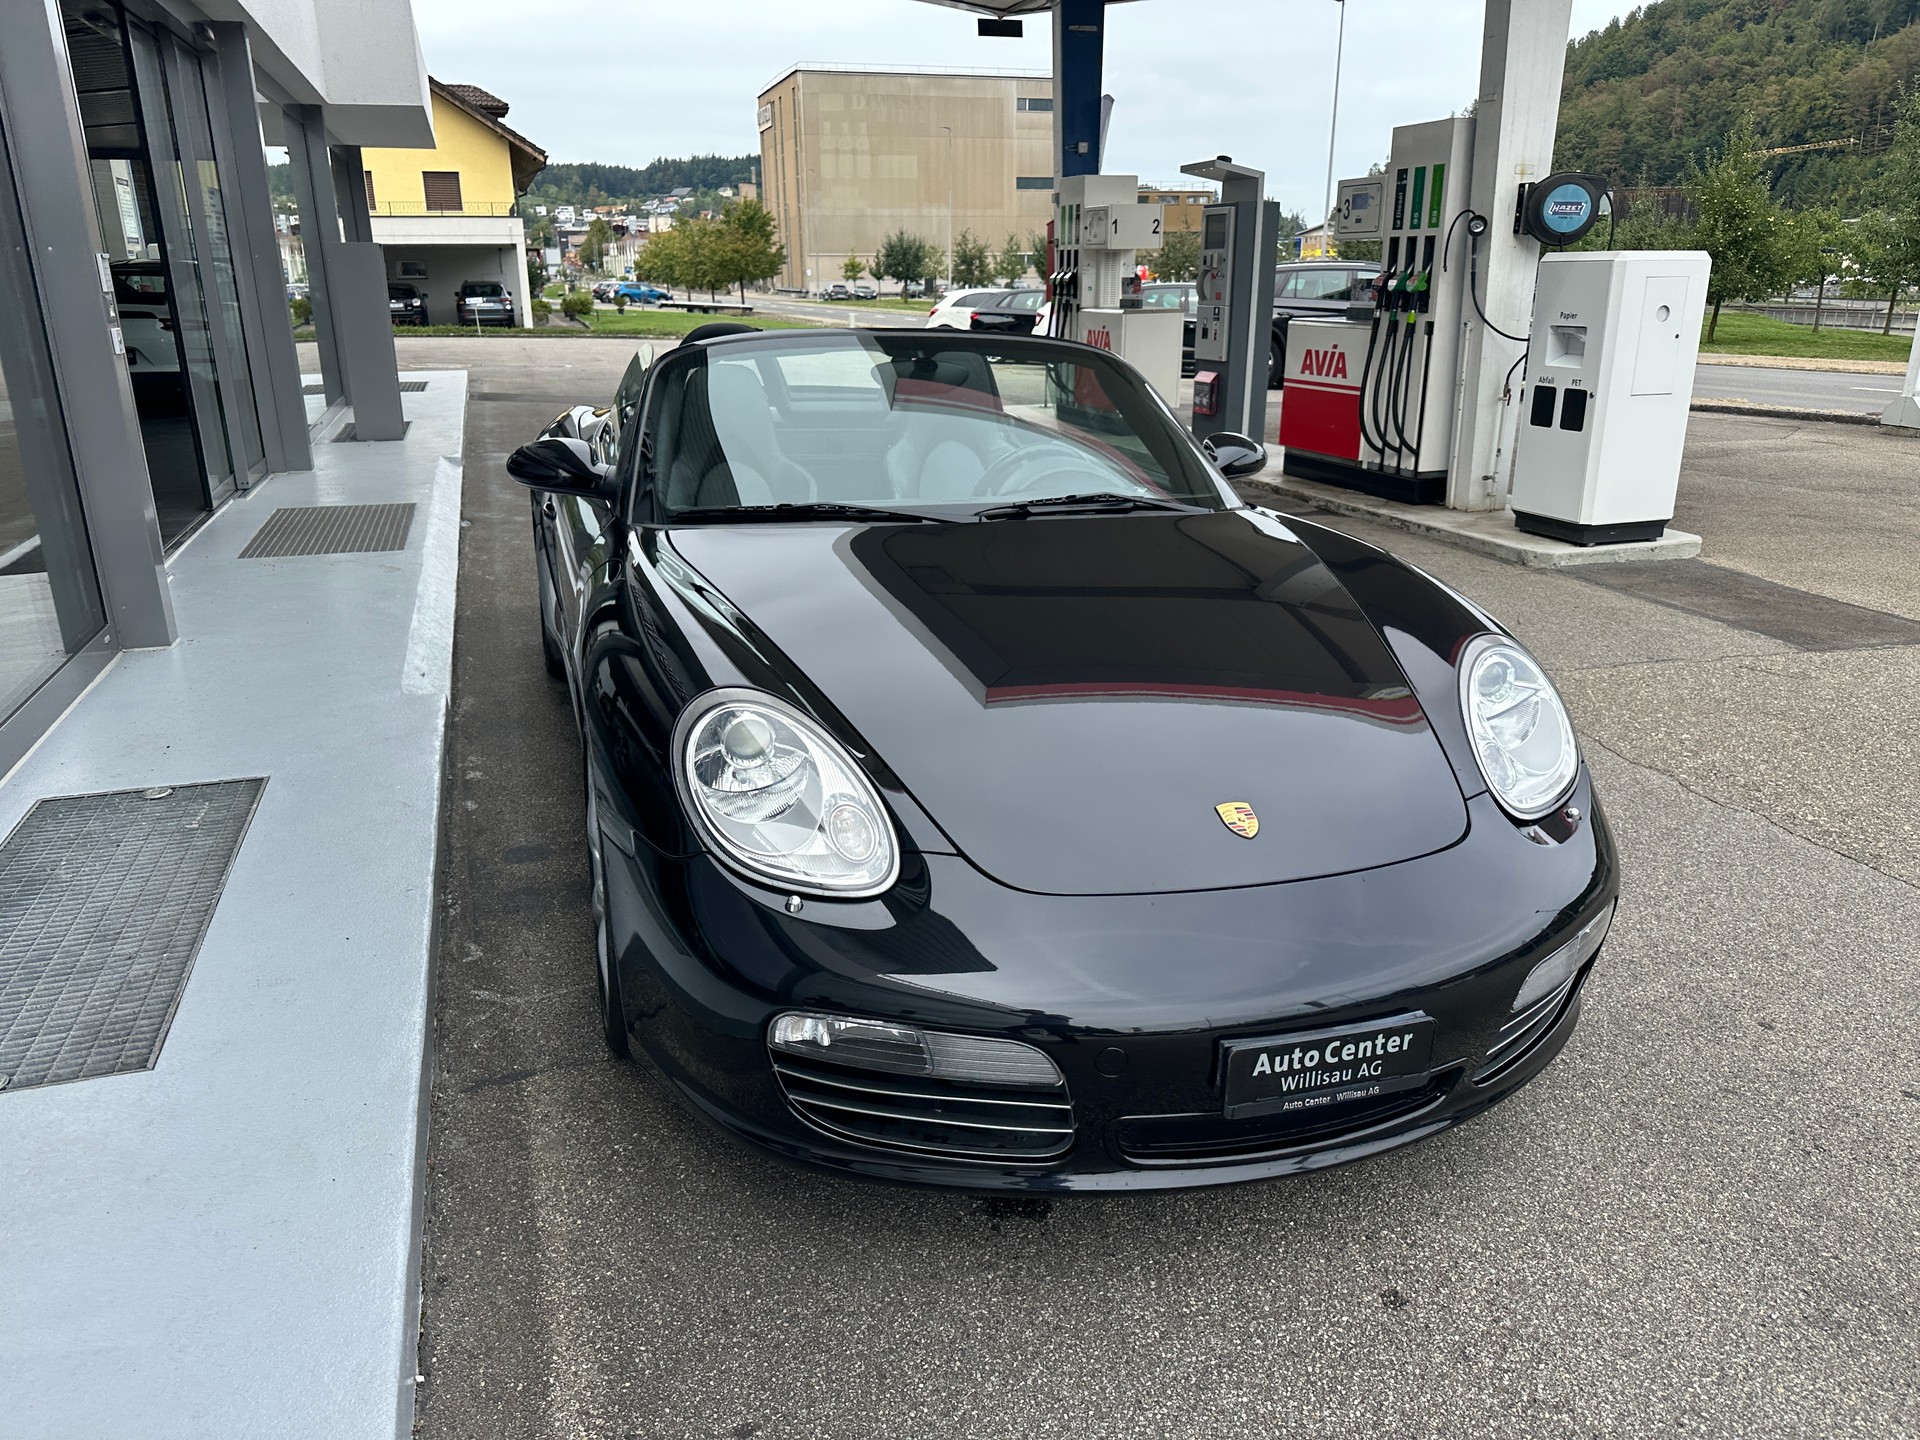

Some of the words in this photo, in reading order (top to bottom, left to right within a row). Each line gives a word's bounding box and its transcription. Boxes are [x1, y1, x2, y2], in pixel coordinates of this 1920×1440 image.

[1343, 198, 1350, 220] 3
[1112, 219, 1118, 234] 1
[1152, 219, 1160, 234] 2
[1559, 311, 1578, 321] Papier
[1538, 375, 1555, 385] Abfall
[1571, 378, 1582, 387] PET
[1252, 1046, 1320, 1077] Auto
[1324, 1031, 1414, 1064] Center
[1281, 1068, 1352, 1092] Willisau
[1357, 1060, 1382, 1079] AG
[1283, 1099, 1303, 1110] Auto
[1304, 1095, 1331, 1107] Center
[1336, 1090, 1367, 1102] Willisau
[1367, 1086, 1380, 1096] AG
